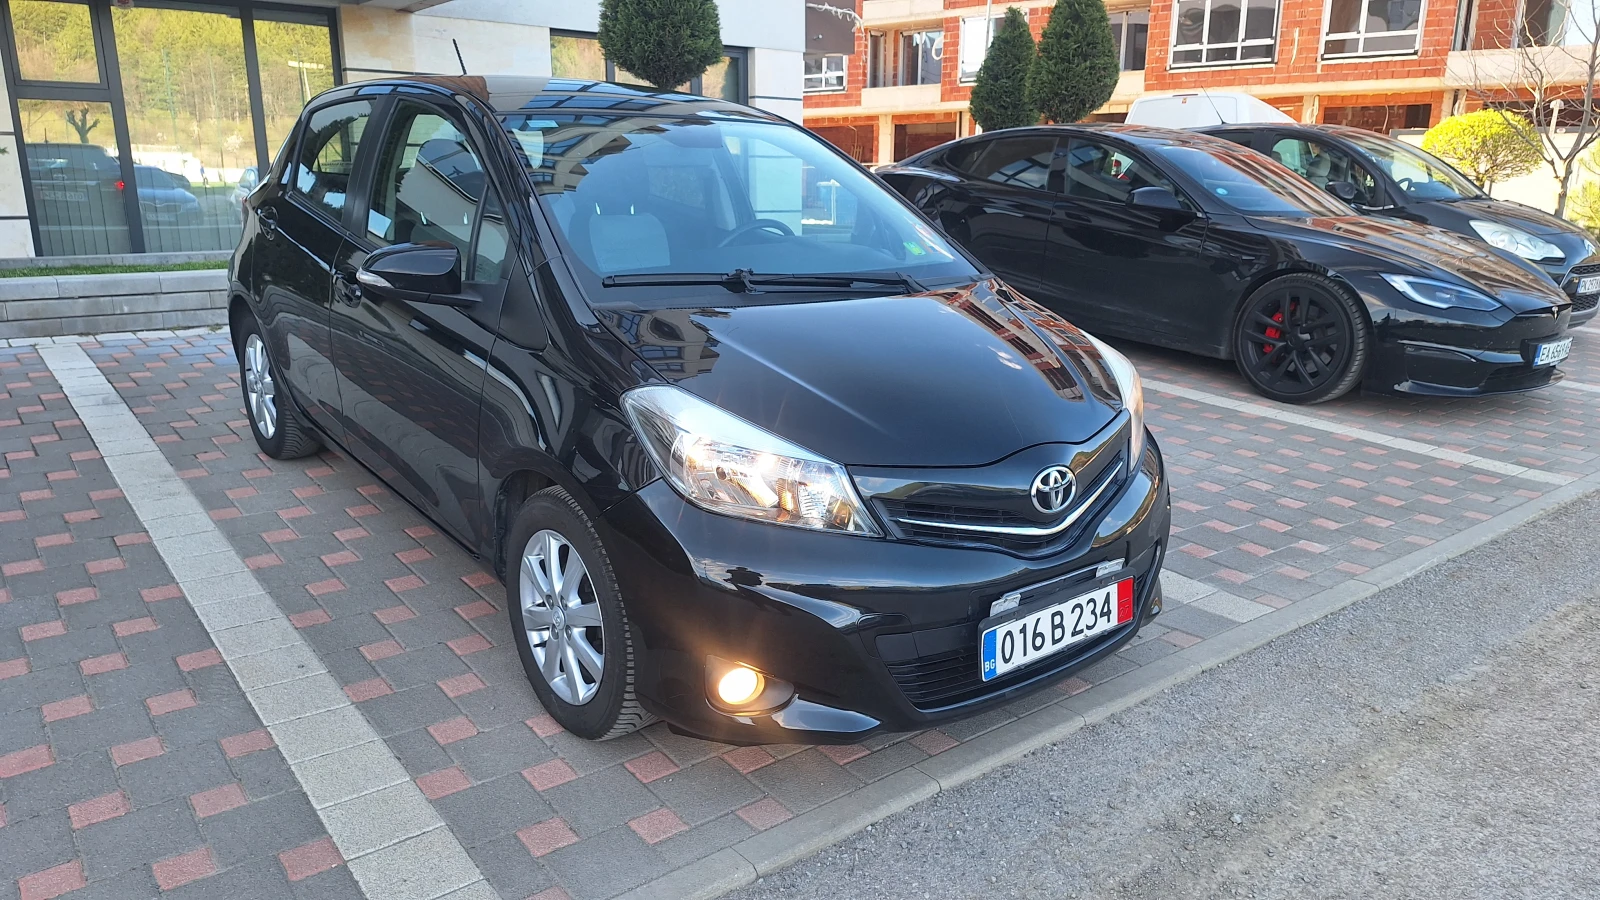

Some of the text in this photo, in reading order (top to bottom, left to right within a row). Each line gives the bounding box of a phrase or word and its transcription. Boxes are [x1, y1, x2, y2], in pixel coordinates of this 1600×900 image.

[1001, 591, 1112, 664] 016 B 234
[984, 659, 996, 673] BG
